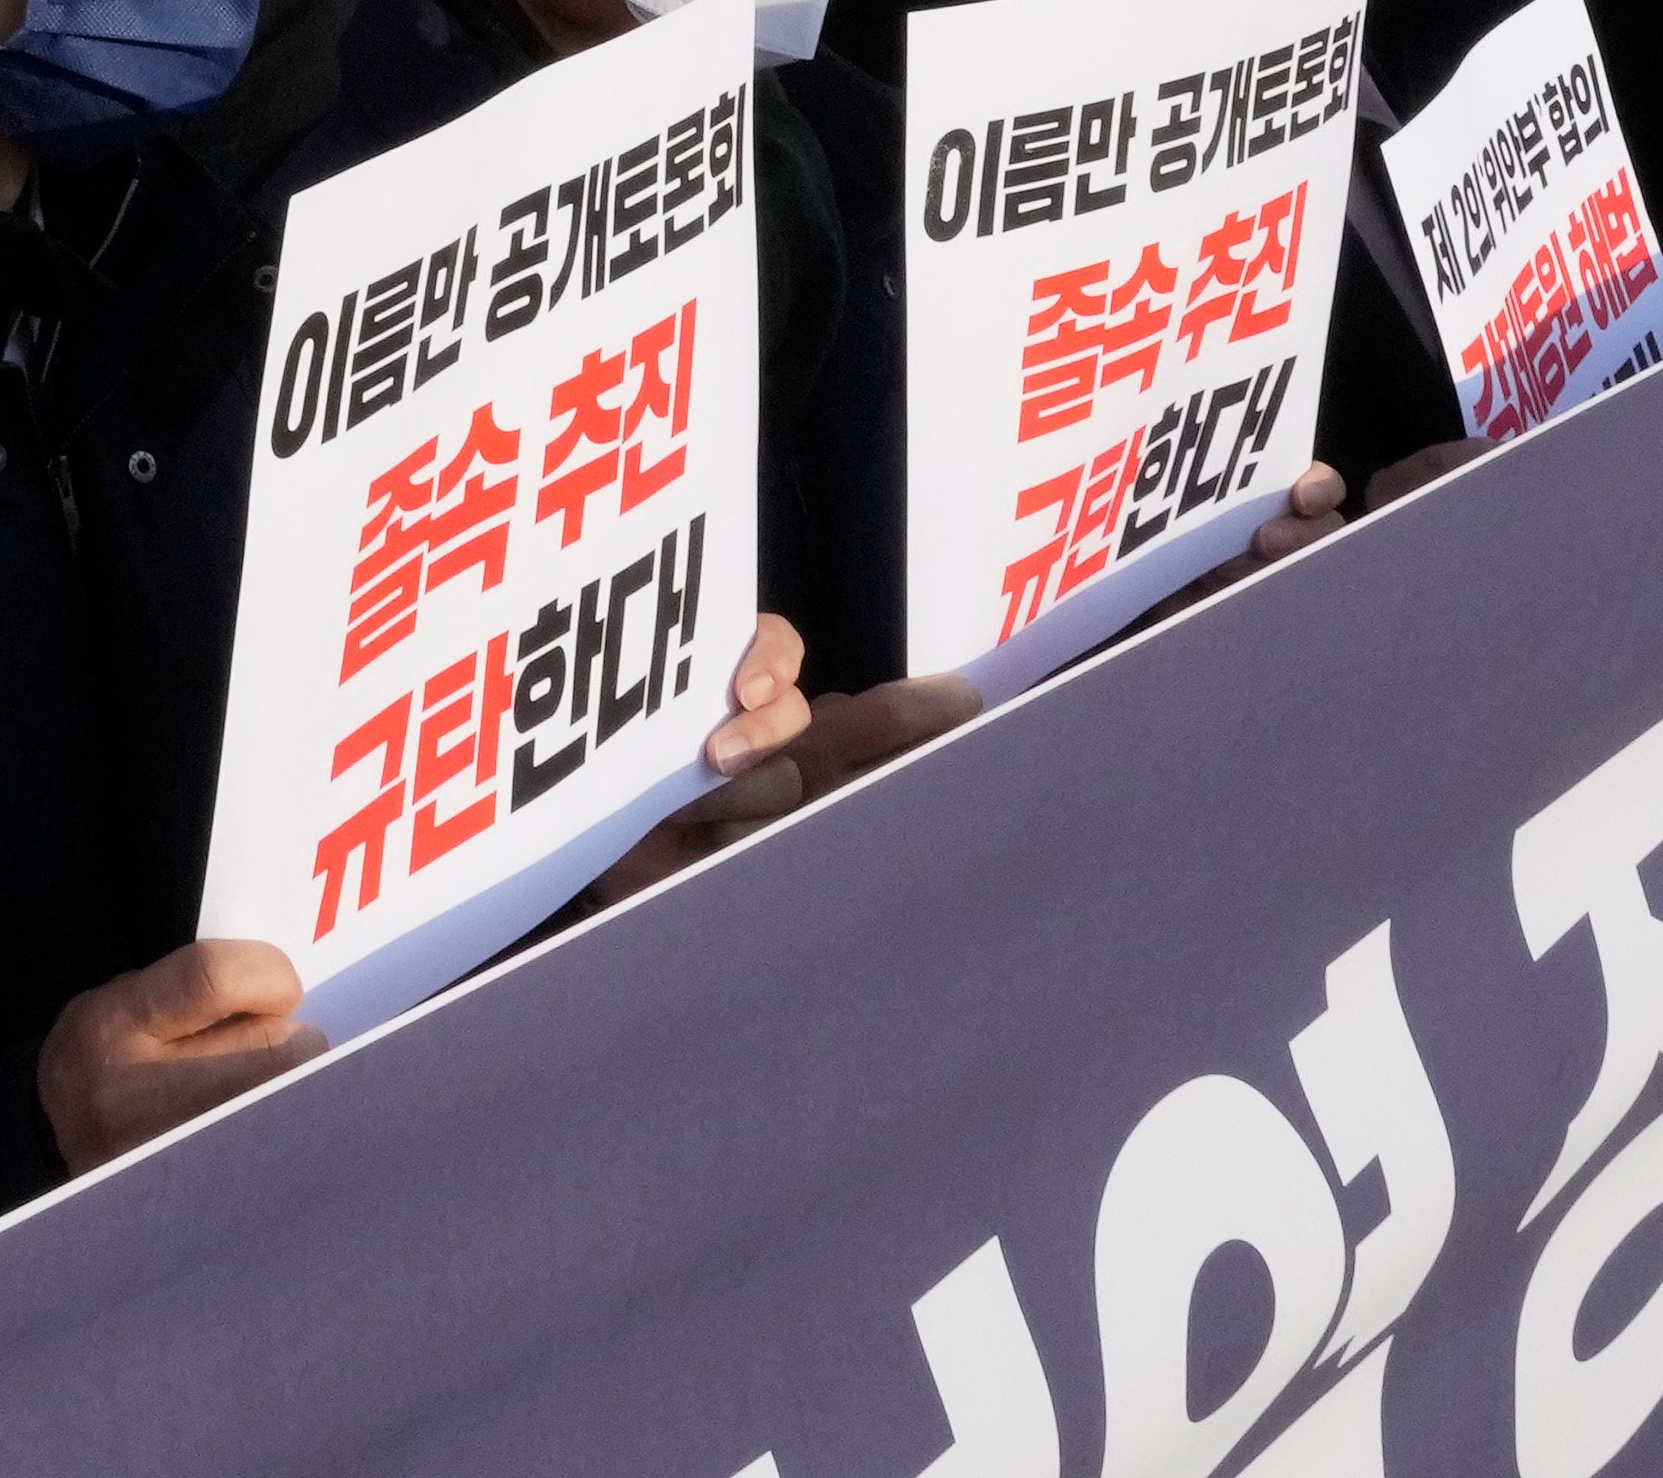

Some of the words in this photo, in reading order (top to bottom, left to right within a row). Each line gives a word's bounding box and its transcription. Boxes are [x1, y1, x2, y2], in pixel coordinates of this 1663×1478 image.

[273, 222, 479, 461] 이름만
[484, 82, 747, 345] 공개토론회
[922, 92, 1137, 244] 이름만
[1149, 10, 1361, 195] 공개토론회
[1568, 168, 1658, 332] 해법
[1017, 240, 1180, 445] 졸속
[1178, 181, 1309, 362] 추진
[338, 400, 522, 689] 졸속
[535, 297, 699, 553] 추진
[998, 356, 1298, 647] 규탄한다!
[312, 512, 707, 946] 규탄한다!
